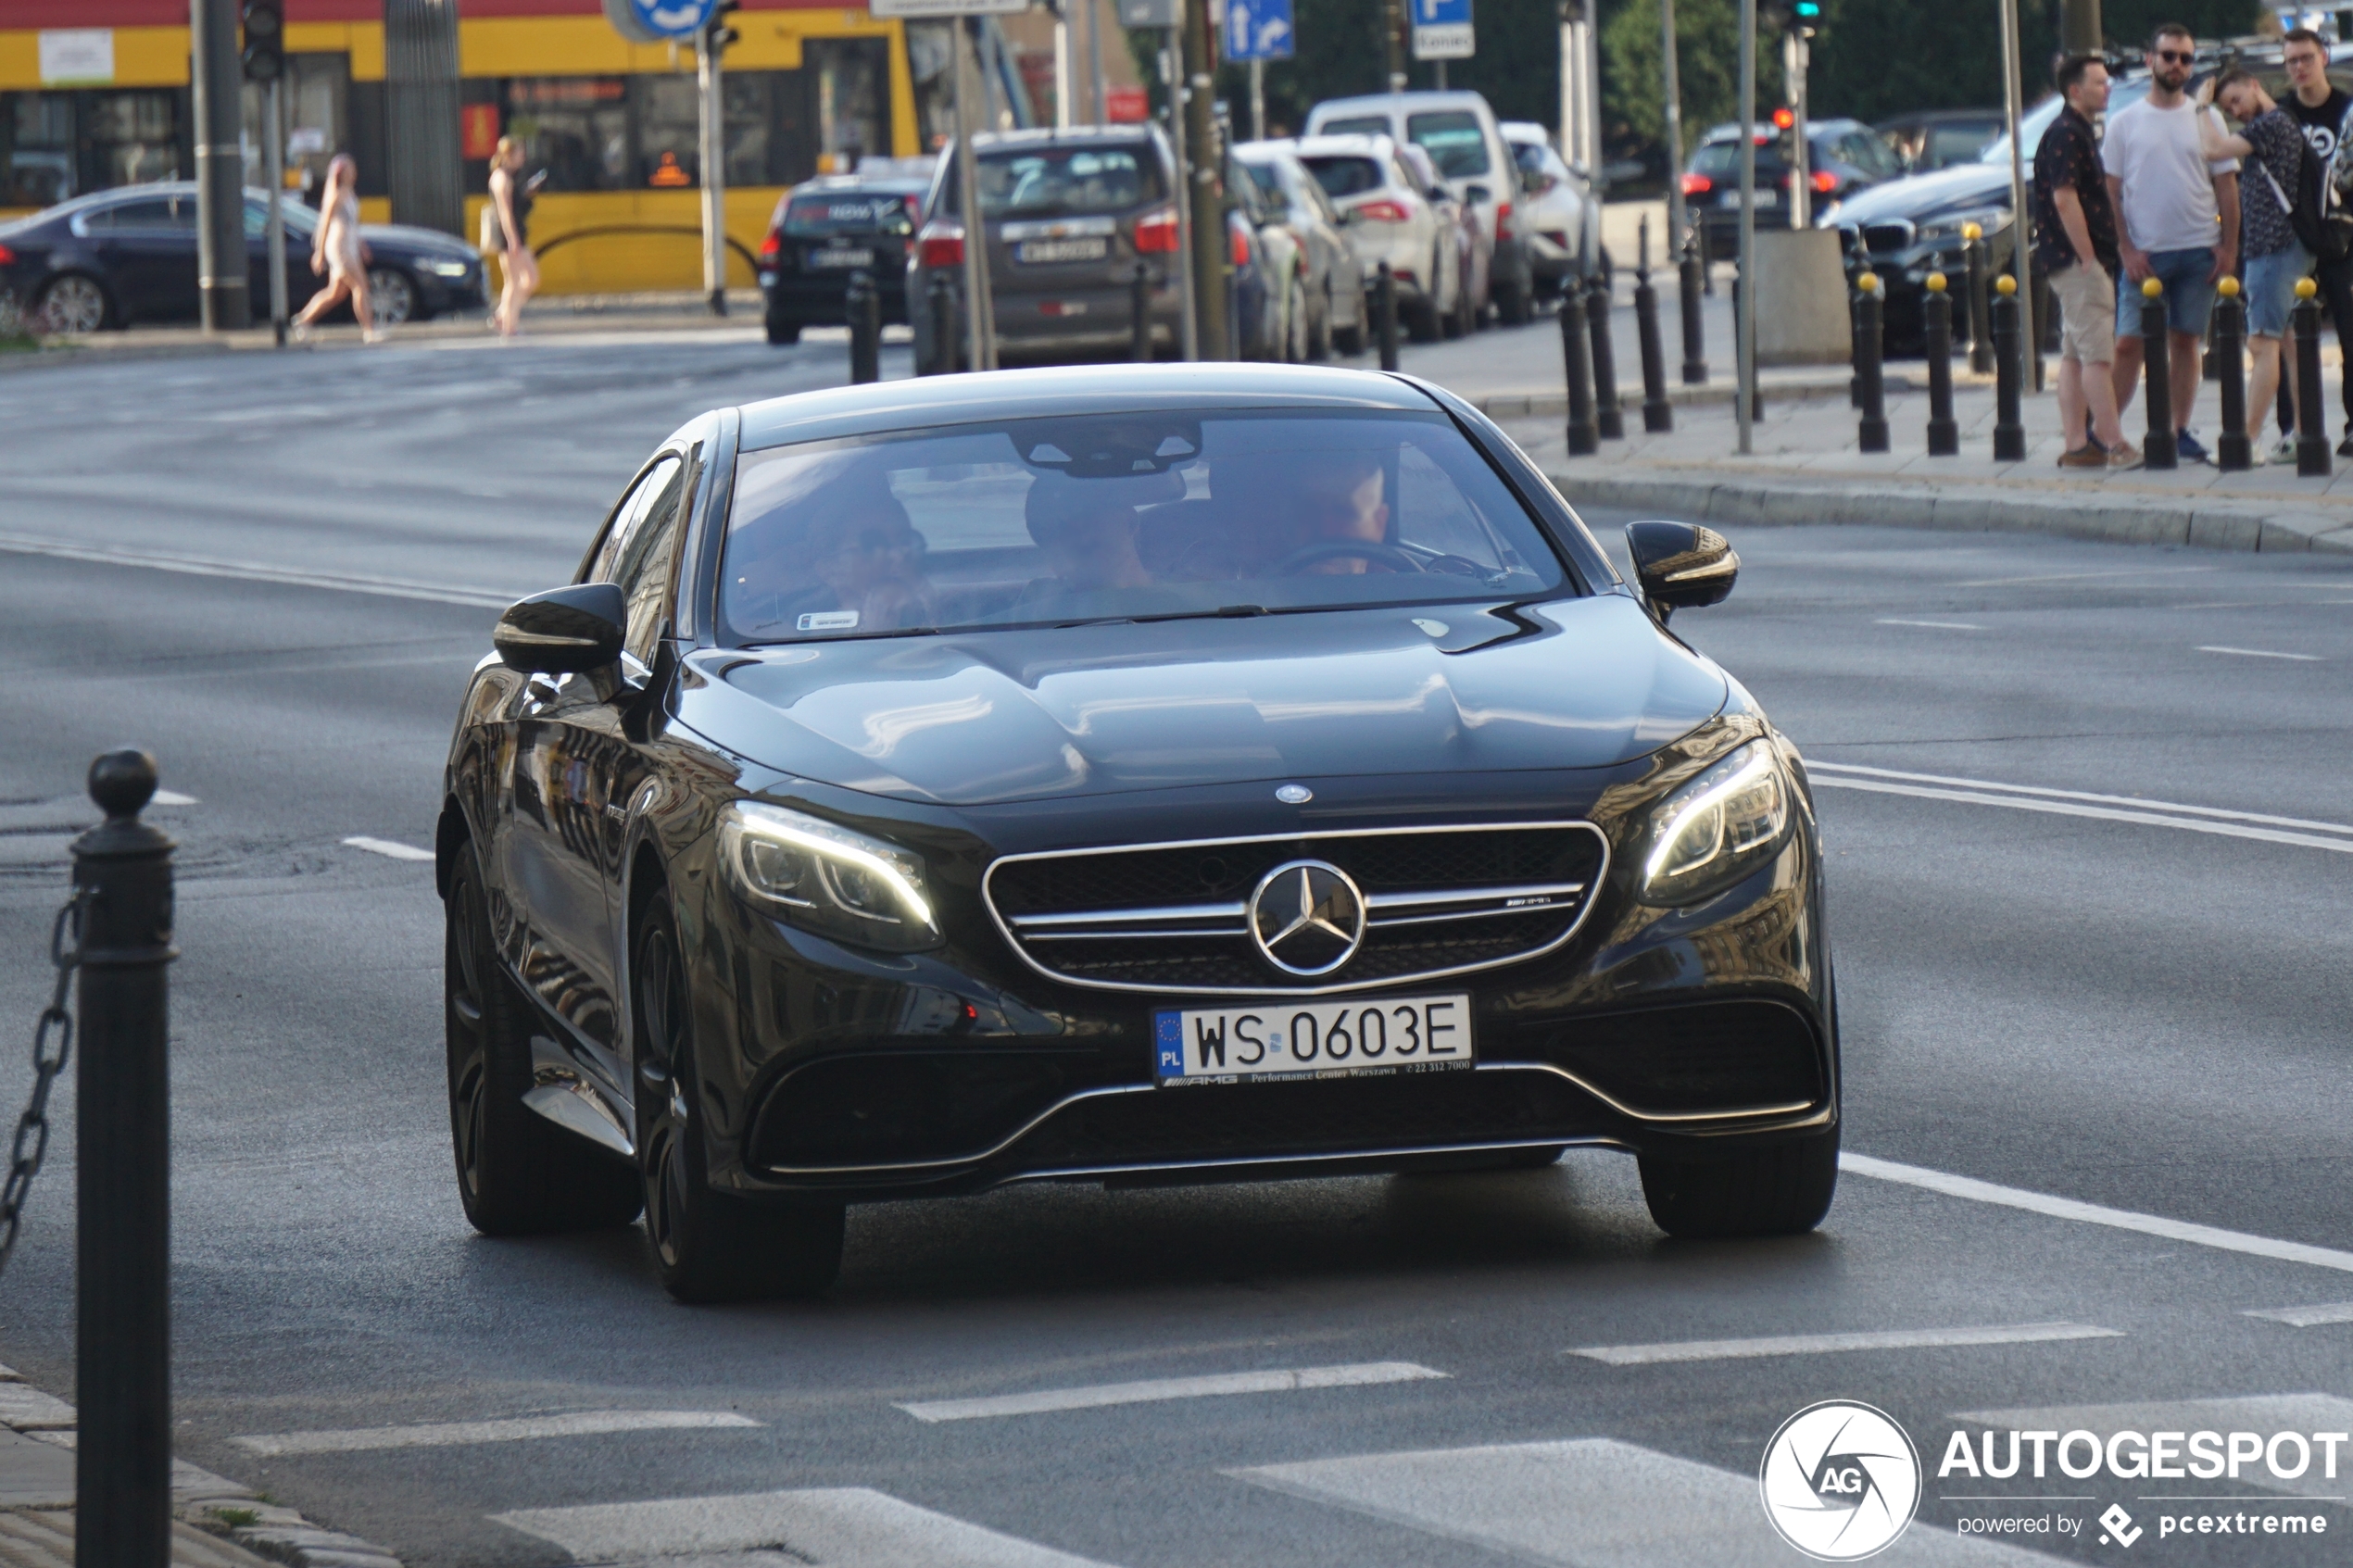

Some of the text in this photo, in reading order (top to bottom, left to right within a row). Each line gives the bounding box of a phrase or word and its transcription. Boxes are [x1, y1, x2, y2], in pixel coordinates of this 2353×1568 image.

[1195, 1002, 1457, 1068] WS 0603E
[1162, 1051, 1181, 1066] PL
[1252, 1071, 1314, 1083] Performance
[1315, 1070, 1348, 1080] Center
[1350, 1067, 1397, 1077] Warszawa
